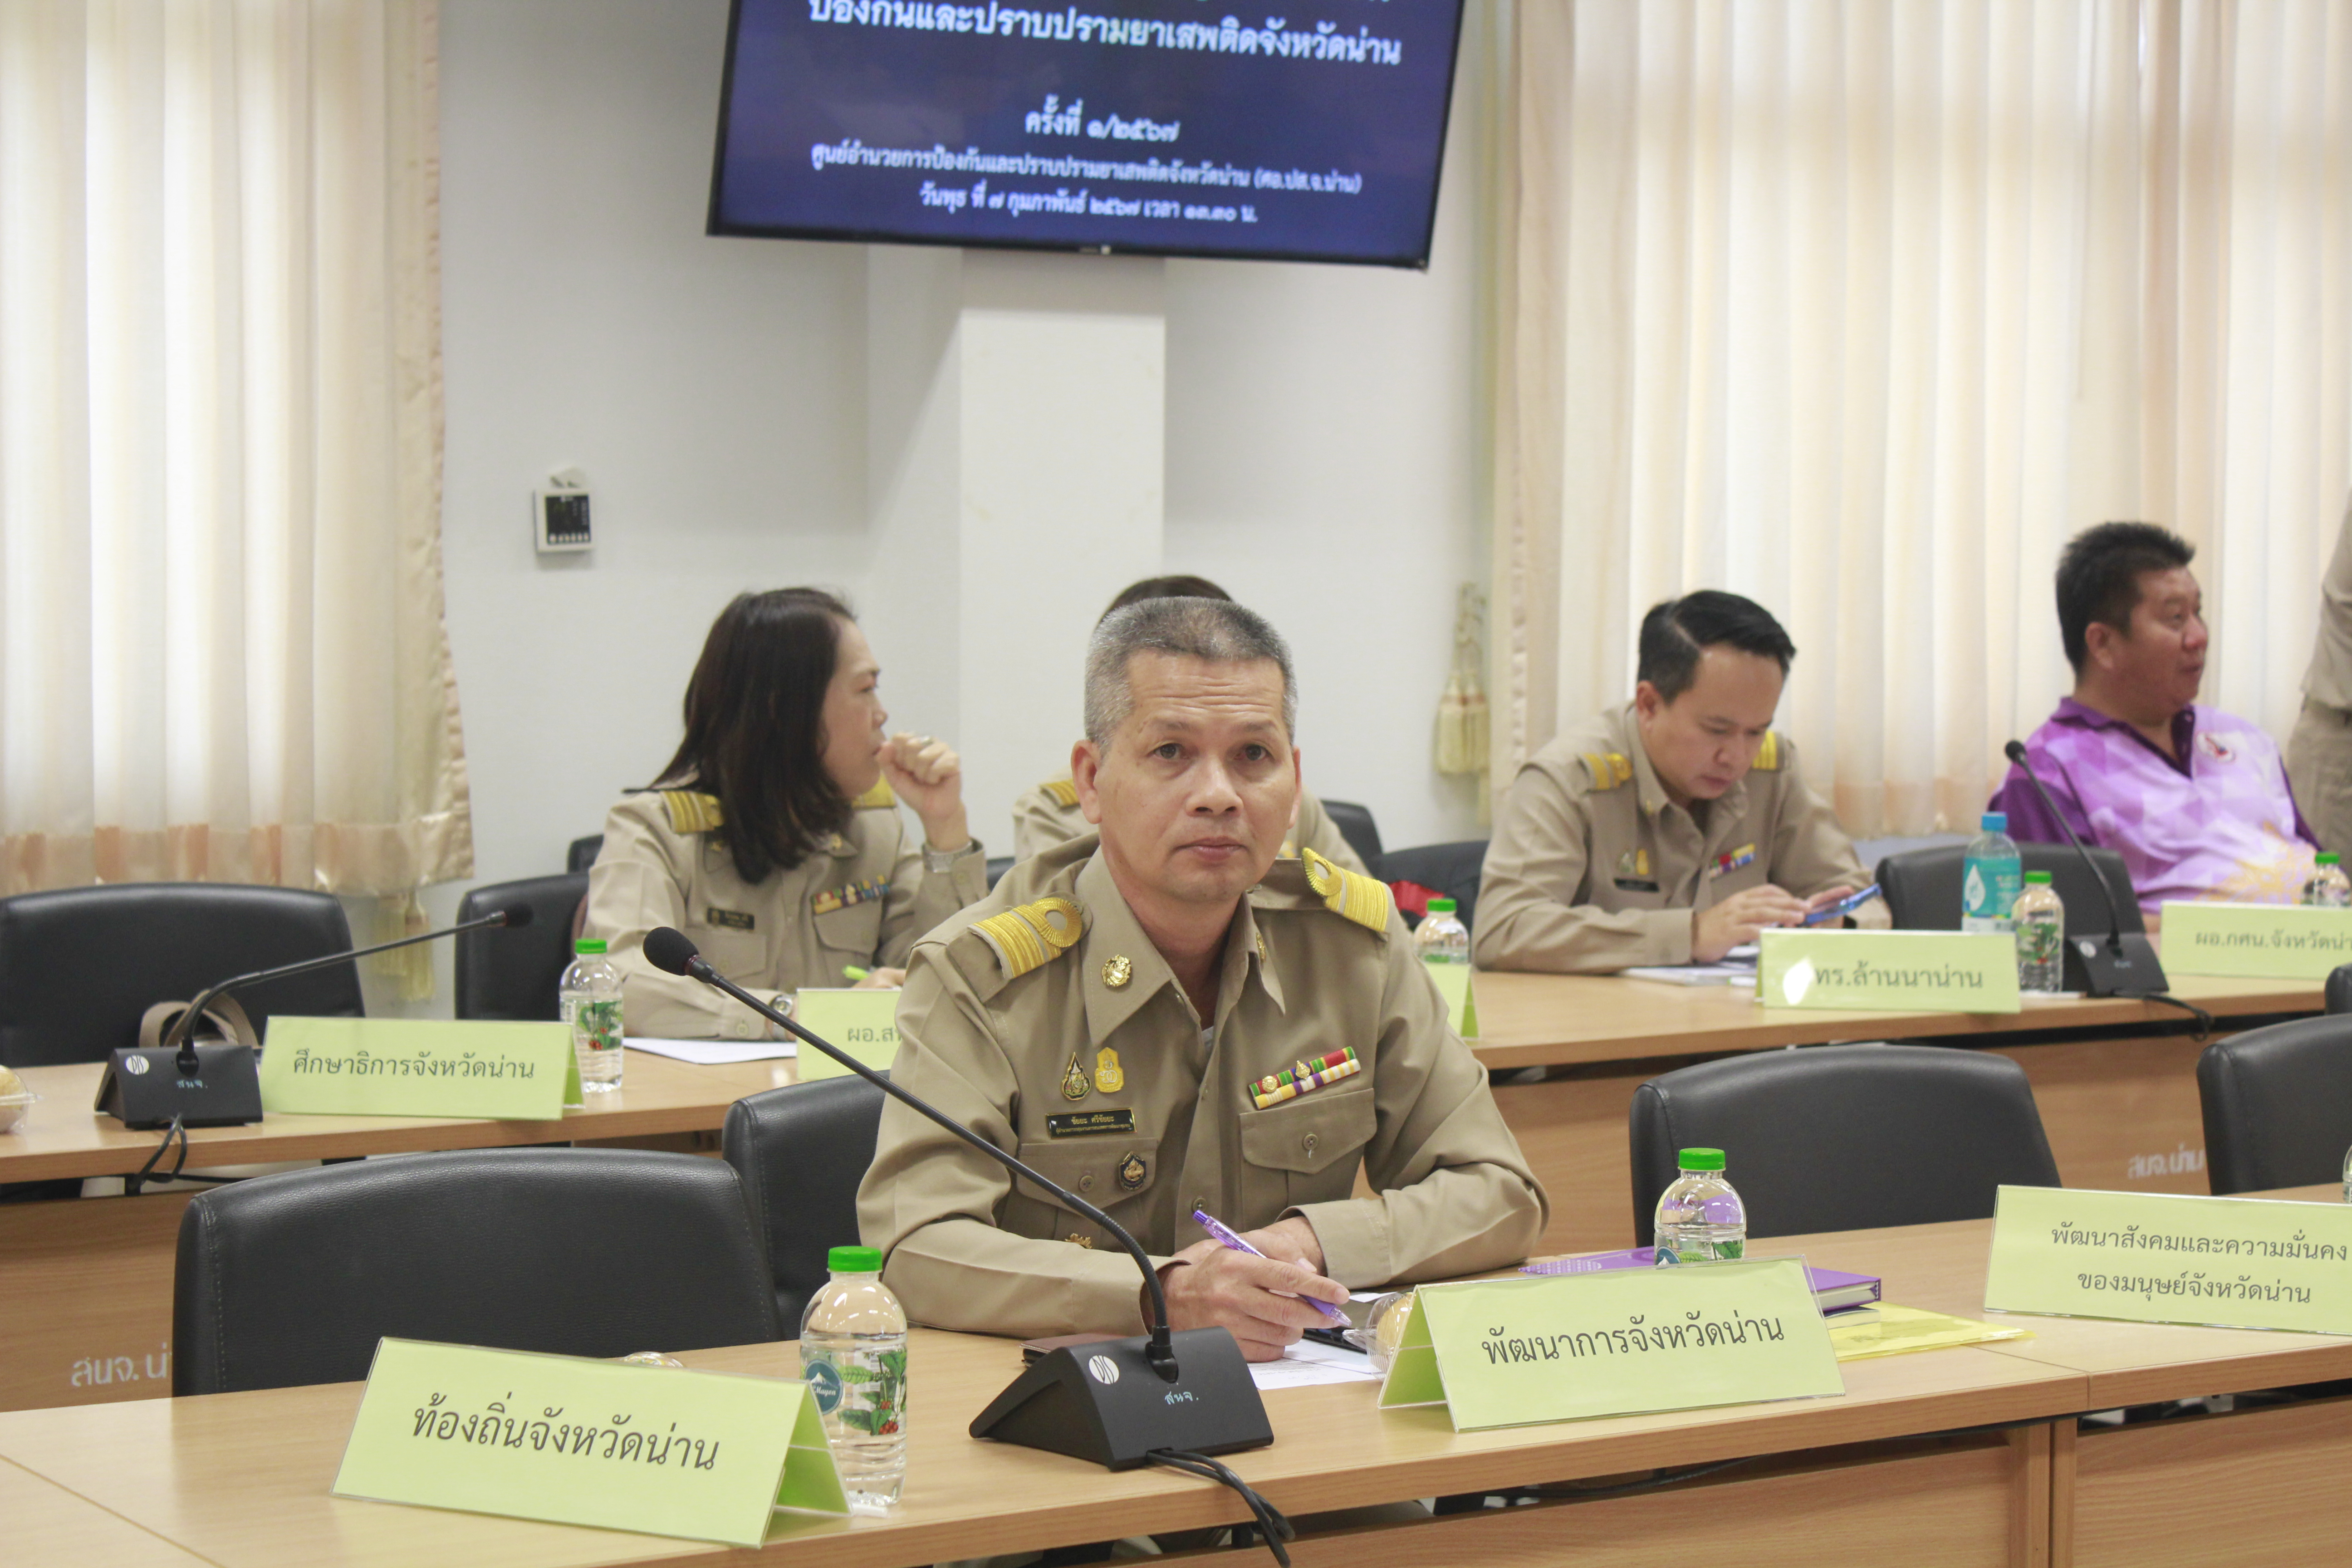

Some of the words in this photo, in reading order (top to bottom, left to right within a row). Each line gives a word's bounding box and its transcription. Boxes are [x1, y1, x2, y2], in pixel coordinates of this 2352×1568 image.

[809, 0, 1402, 65] ปองกนและปราบปรามยาเสพติดจังหวัดน่าน
[1025, 93, 1083, 136] ครั้งที่
[1087, 113, 1181, 142] ๑/๒๕๖๗
[919, 180, 966, 214] วันพุธ
[970, 179, 987, 208] ที่
[1008, 186, 1088, 217] กุมภาพันธ์
[1143, 200, 1180, 219] เวลา
[1814, 959, 1984, 989] ทร.ล้านนาน่าน
[294, 1048, 535, 1079] ศึกษาธิการจังหวัดน่าน
[2052, 1221, 2347, 1261] พัฒนาสังคมและความมั่นคง
[2078, 1271, 2311, 1303] ของมนุษย์จังหวัดน่าน
[1481, 1309, 1784, 1364] พัฒนาการจังหวัดน่าน
[413, 1391, 720, 1470] ท้องถิ่นจังหวัดน่าน
